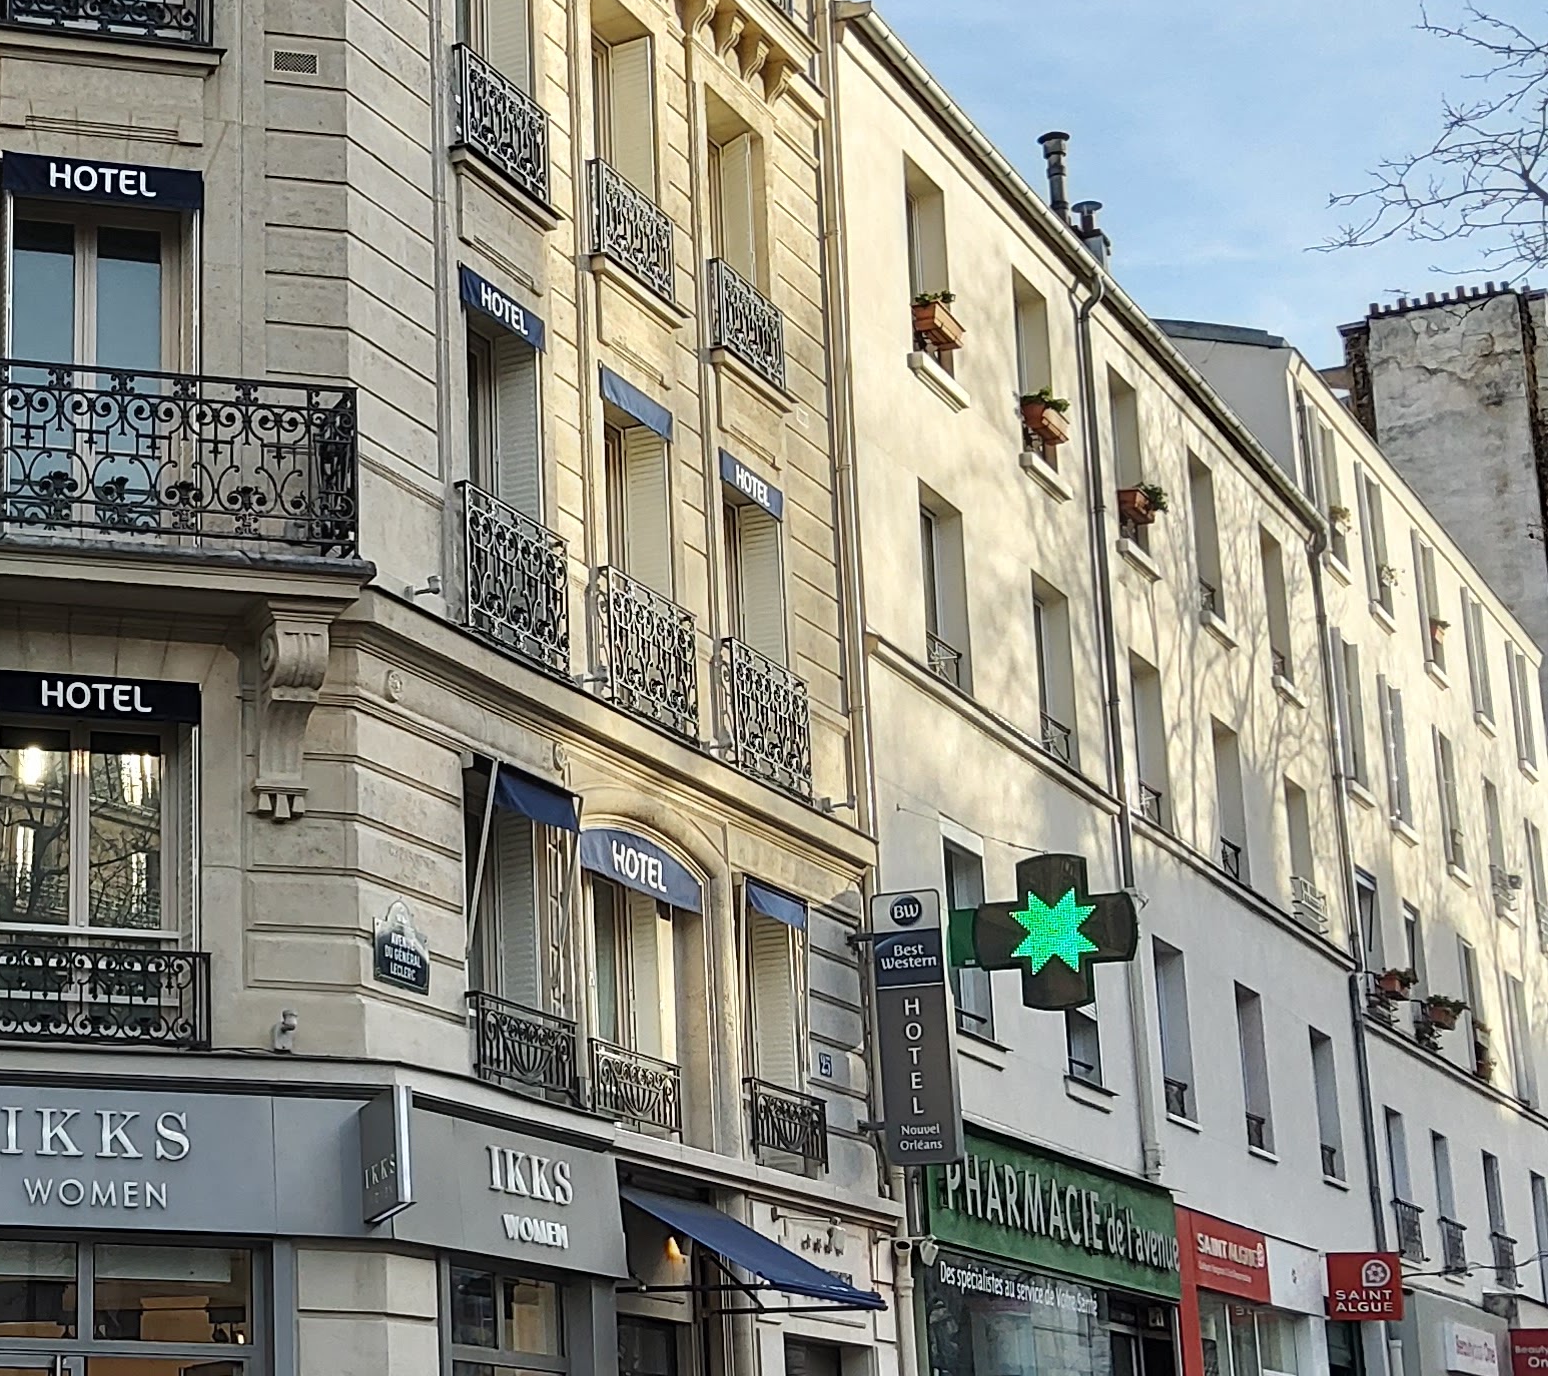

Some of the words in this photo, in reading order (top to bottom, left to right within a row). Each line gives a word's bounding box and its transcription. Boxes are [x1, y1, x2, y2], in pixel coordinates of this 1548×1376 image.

[49, 162, 157, 197] HOTEL
[480, 282, 529, 336] HOTEL
[735, 464, 770, 507] HOTEL
[41, 679, 152, 712] HOTEL
[612, 839, 668, 893] HOTEL
[893, 904, 920, 919] BW
[384, 944, 393, 959] DU
[394, 946, 422, 968] GÉNÉRAL
[881, 955, 937, 970] Western
[893, 944, 924, 957] Best
[390, 962, 416, 981] LECLERC
[904, 998, 925, 1114] HOTEL
[0, 1106, 191, 1161] IKKS
[900, 1137, 943, 1151] Orléans
[901, 1123, 941, 1136] Nouvel
[365, 1153, 396, 1189] IKKS
[486, 1145, 573, 1205] IKKS
[23, 1177, 169, 1209] WOMEN
[946, 1152, 1104, 1251] PHARMACIE
[1106, 1203, 1125, 1255] de
[1126, 1207, 1181, 1273] l'avenue
[502, 1213, 569, 1249] WOMEN
[1197, 1232, 1228, 1260] SAINT
[1228, 1241, 1258, 1269] ALGUE
[940, 1260, 956, 1285] Des
[957, 1263, 1003, 1295] spécialistes
[1004, 1279, 1015, 1297] au
[1017, 1281, 1043, 1304] service
[1044, 1284, 1054, 1306] de
[1335, 1289, 1393, 1301] SAINT
[1335, 1301, 1394, 1313] ALGUE
